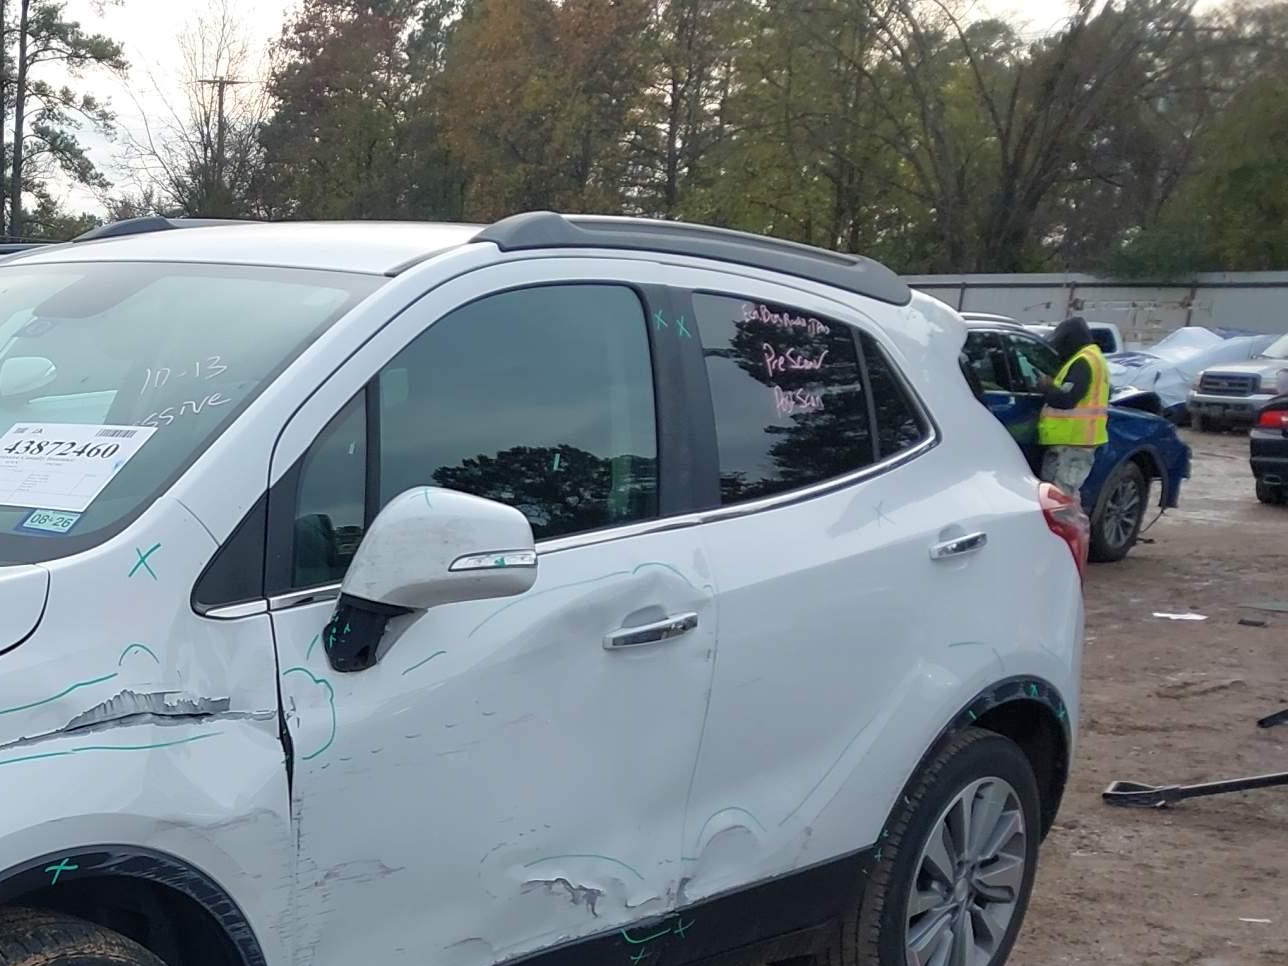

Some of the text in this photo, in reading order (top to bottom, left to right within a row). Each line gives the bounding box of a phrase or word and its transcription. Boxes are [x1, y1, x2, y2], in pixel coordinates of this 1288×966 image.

[4, 439, 120, 459] 43872460
[29, 513, 74, 528] 08 26
